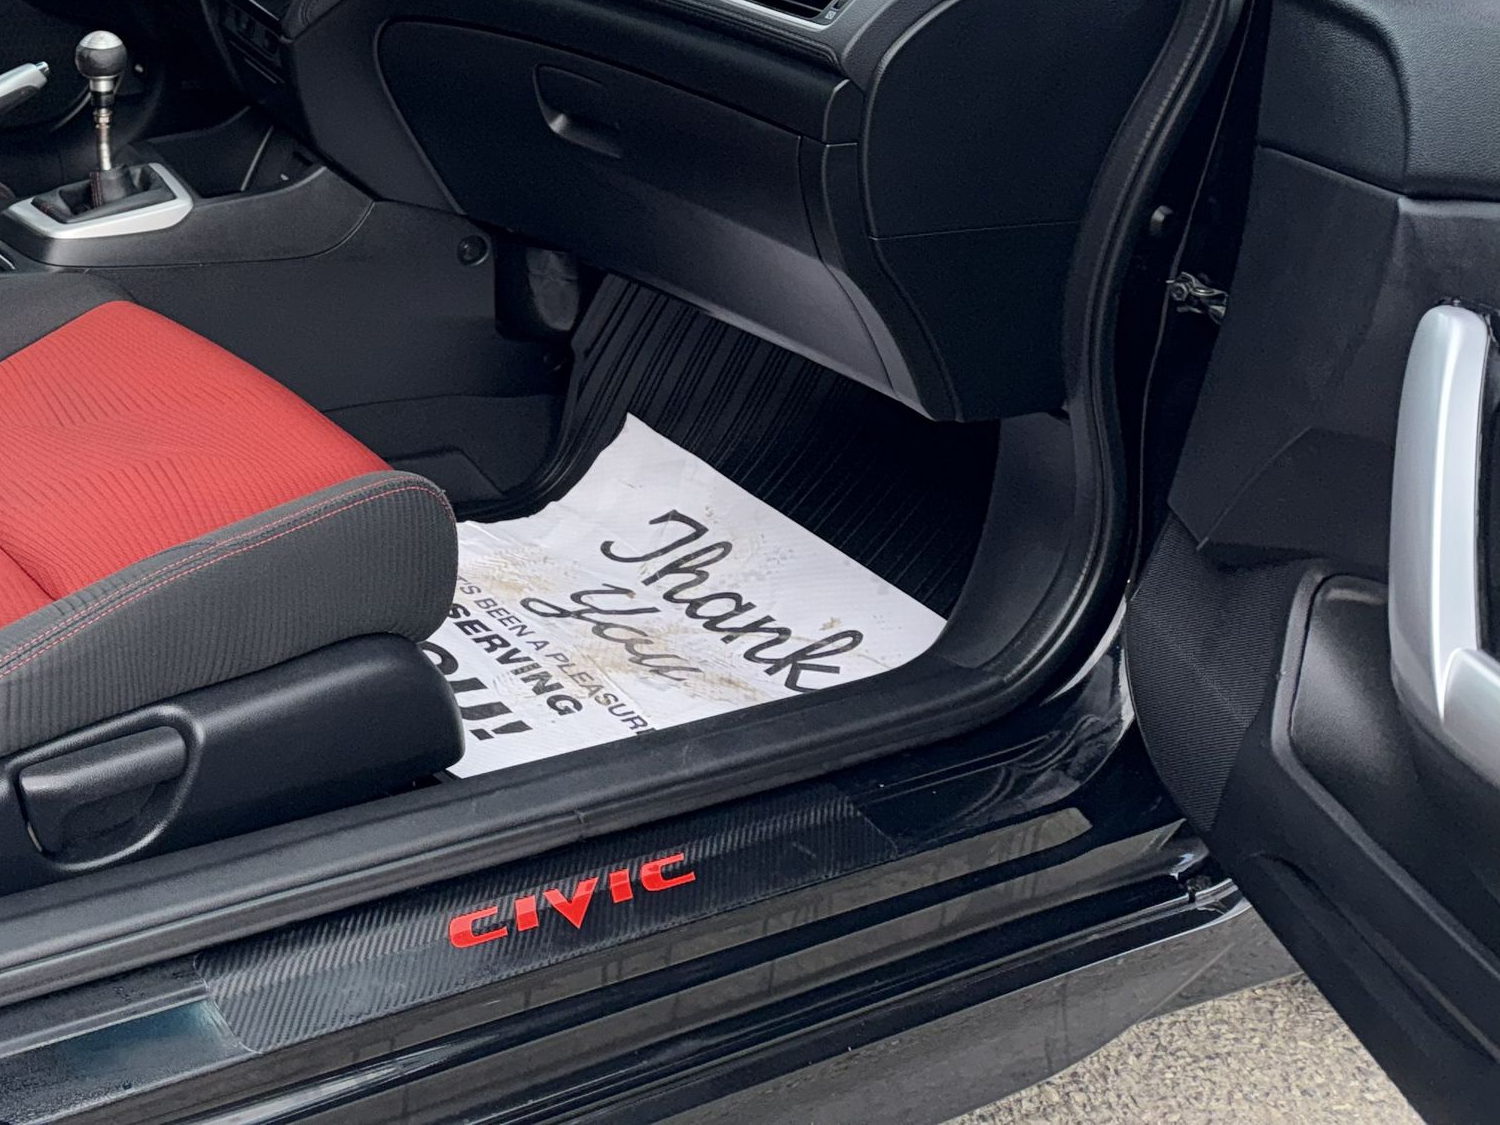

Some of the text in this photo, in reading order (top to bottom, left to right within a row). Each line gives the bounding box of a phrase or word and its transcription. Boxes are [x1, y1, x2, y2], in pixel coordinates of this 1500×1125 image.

[473, 597, 535, 638] BEEN
[526, 639, 550, 651] A
[521, 583, 704, 683] You
[600, 509, 863, 692] Thank
[448, 602, 584, 717] SERVING
[448, 852, 696, 948] CIVIC
